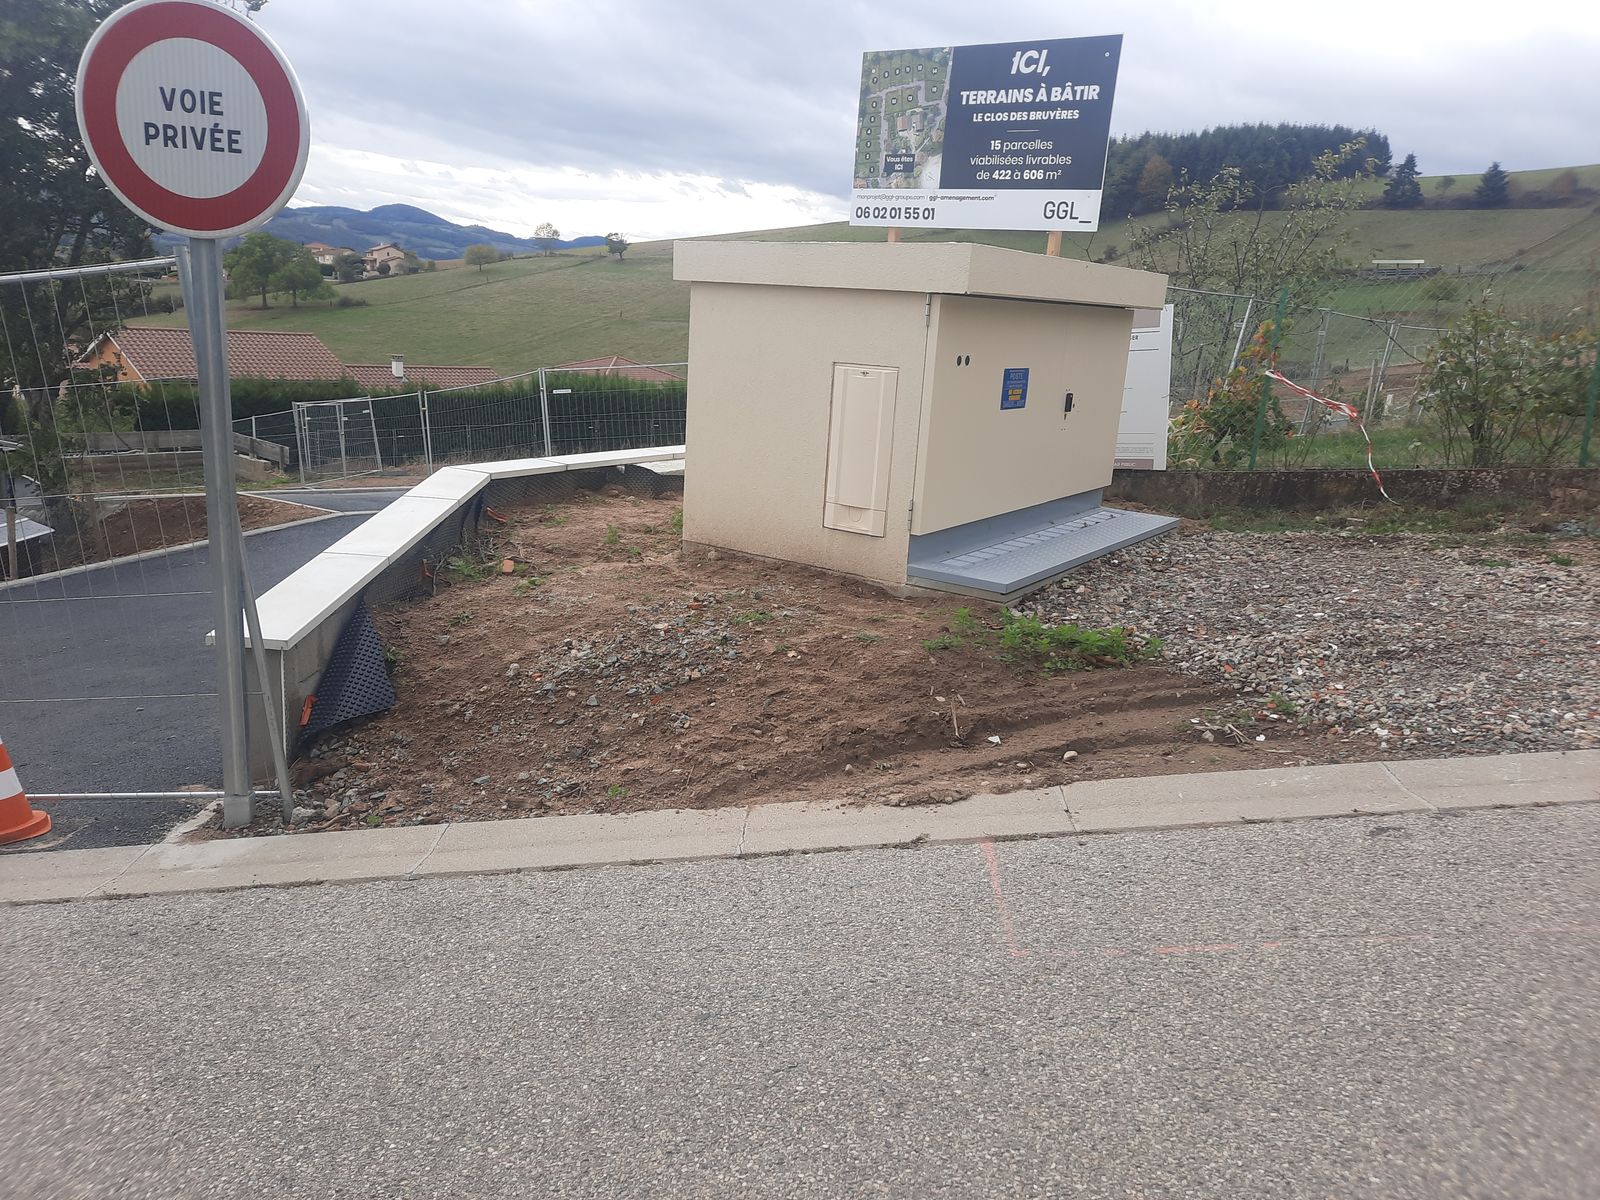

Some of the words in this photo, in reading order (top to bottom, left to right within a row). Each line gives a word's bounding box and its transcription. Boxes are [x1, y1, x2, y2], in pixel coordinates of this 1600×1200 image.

[1011, 50, 1051, 76] ICI,
[961, 88, 1034, 105] TERRAINS
[1036, 83, 1047, 102] À
[1051, 82, 1100, 101] BÂTIR
[160, 87, 224, 116] VOIE
[973, 113, 983, 122] LE
[984, 113, 1009, 122] CLOS
[1010, 112, 1028, 121] DES
[1030, 108, 1079, 120] BRUYÈRES
[144, 122, 242, 154] PRIVÉE
[991, 141, 1001, 150] 15
[1003, 140, 1053, 152] parcelles
[970, 155, 1023, 165] viabilisées
[1026, 154, 1072, 165] livrables
[977, 170, 990, 180] de
[992, 170, 1011, 179] 422
[1014, 170, 1020, 179] à
[1024, 170, 1043, 179] 606
[1046, 170, 1062, 179] m²
[856, 207, 870, 219] 06
[873, 207, 887, 219] 02
[890, 208, 901, 220] 01
[904, 208, 920, 220] 55
[923, 208, 935, 220] 01
